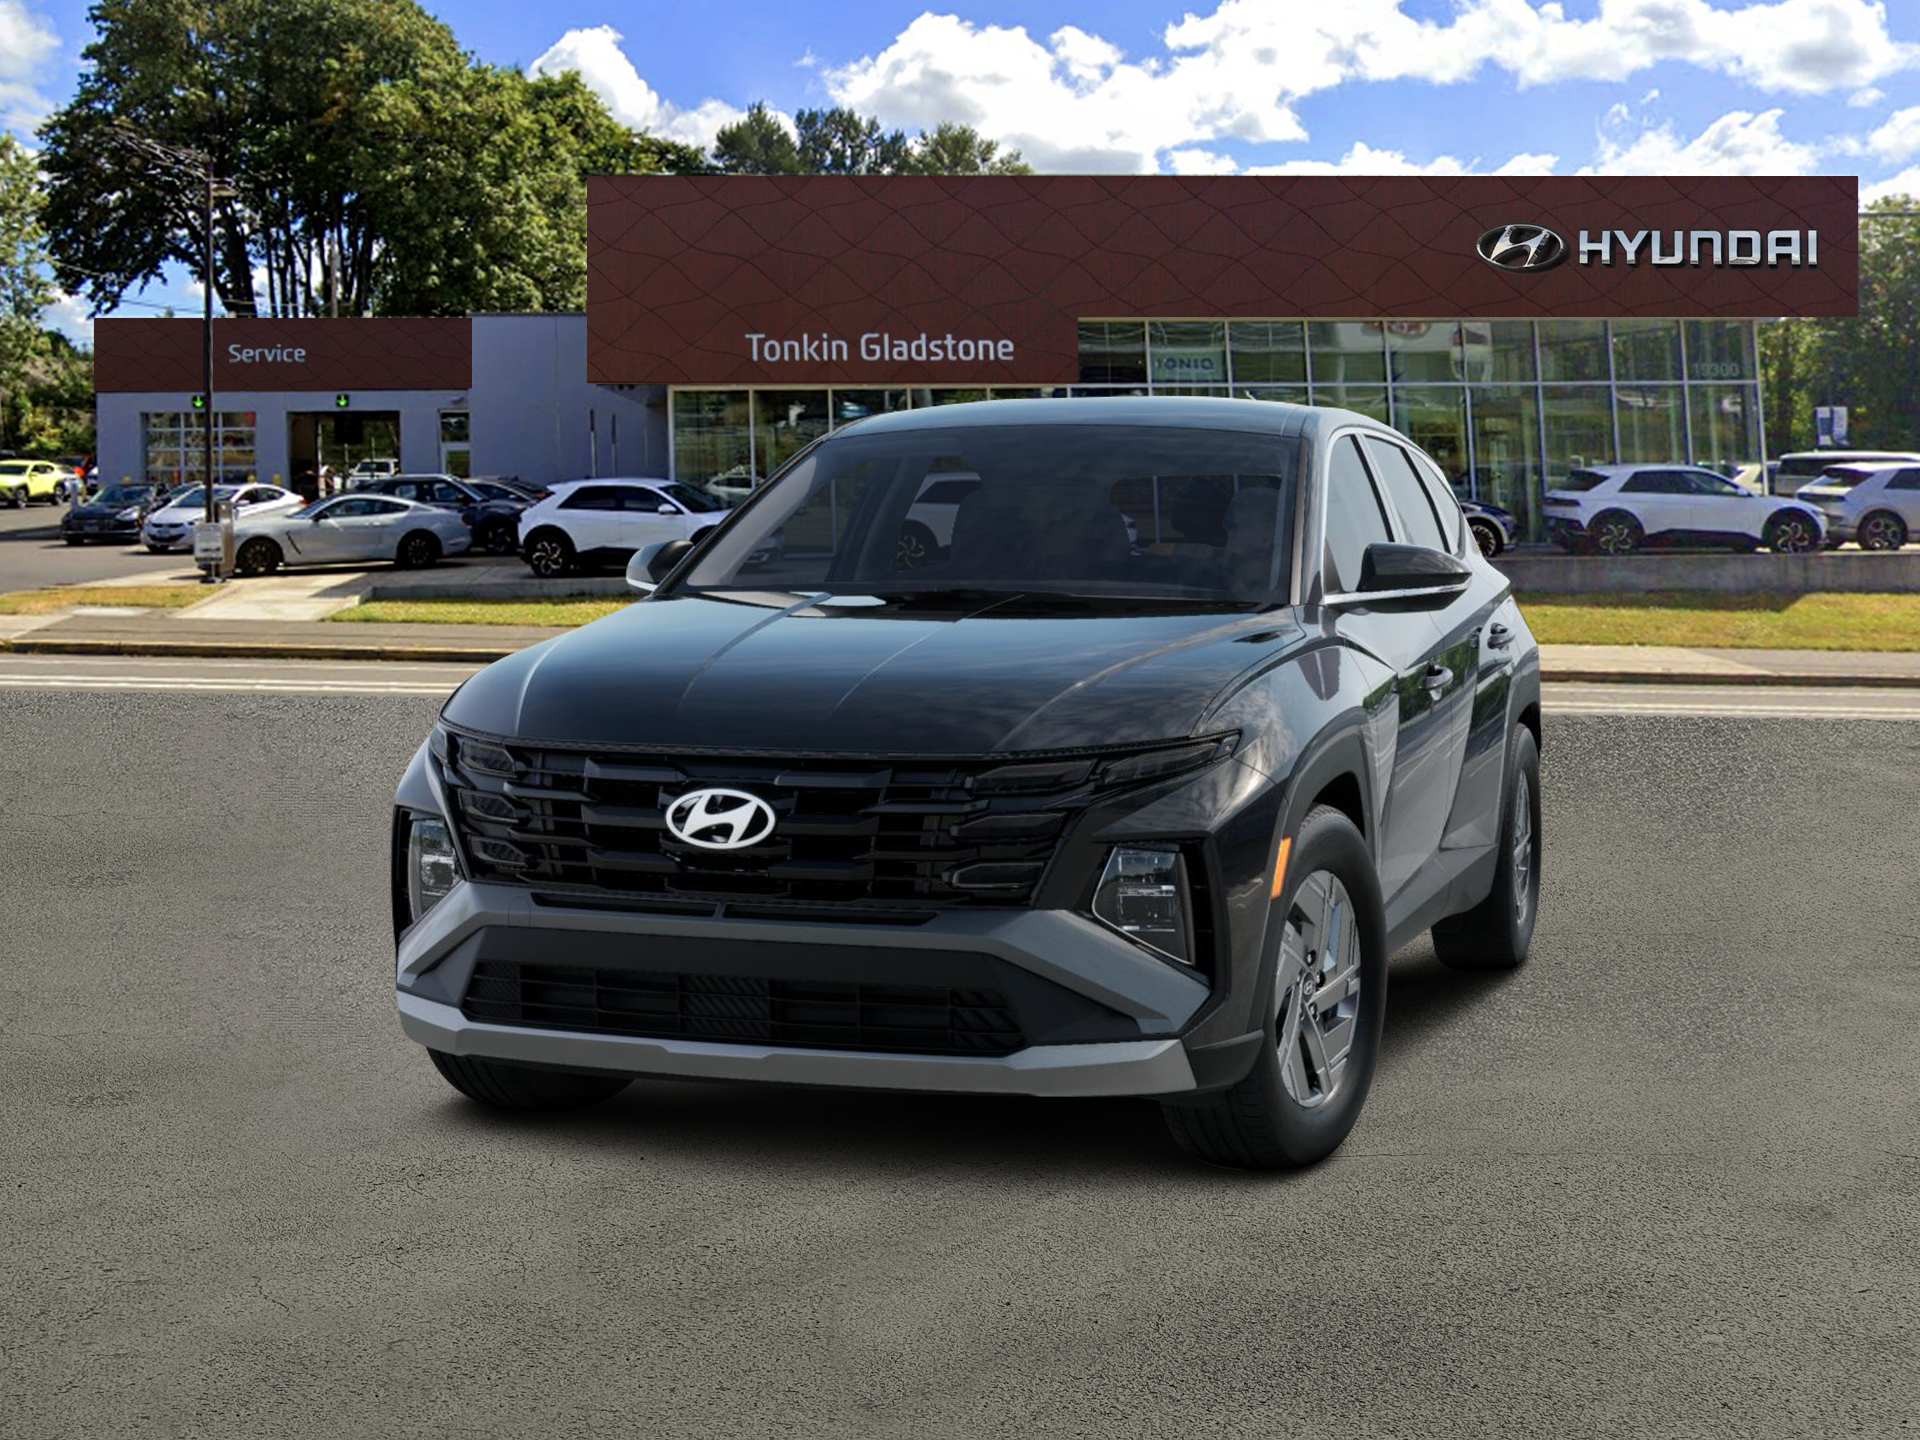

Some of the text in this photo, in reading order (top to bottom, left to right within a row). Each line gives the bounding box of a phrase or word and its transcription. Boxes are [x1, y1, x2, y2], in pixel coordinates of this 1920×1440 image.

[1579, 230, 1817, 265] HYUNDAI
[228, 343, 307, 363] Service
[745, 333, 1015, 362] Tonkin Gladstone
[1157, 357, 1214, 370] IONIQ
